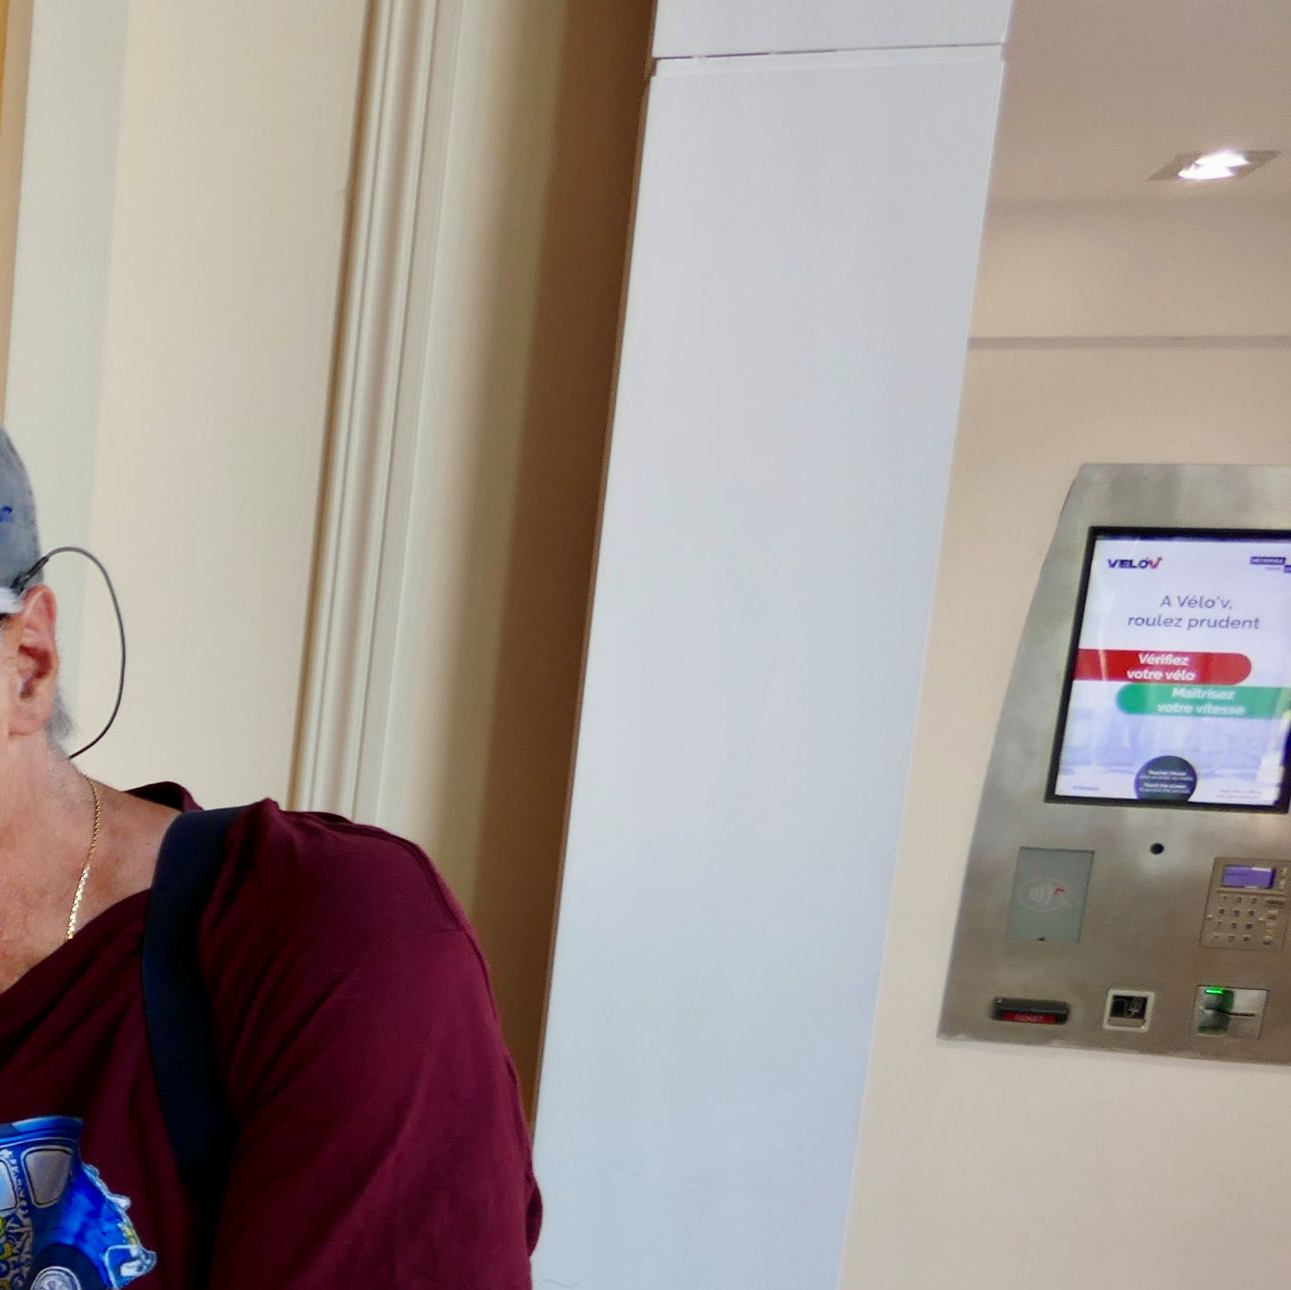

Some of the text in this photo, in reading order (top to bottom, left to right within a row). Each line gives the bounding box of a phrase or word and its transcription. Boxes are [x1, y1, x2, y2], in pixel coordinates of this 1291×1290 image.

[1127, 615, 1261, 631] roulez prudent
[1138, 653, 1190, 666] Vérifiez
[1126, 668, 1196, 681] votre vélo
[1156, 702, 1246, 716] votre vitesse
